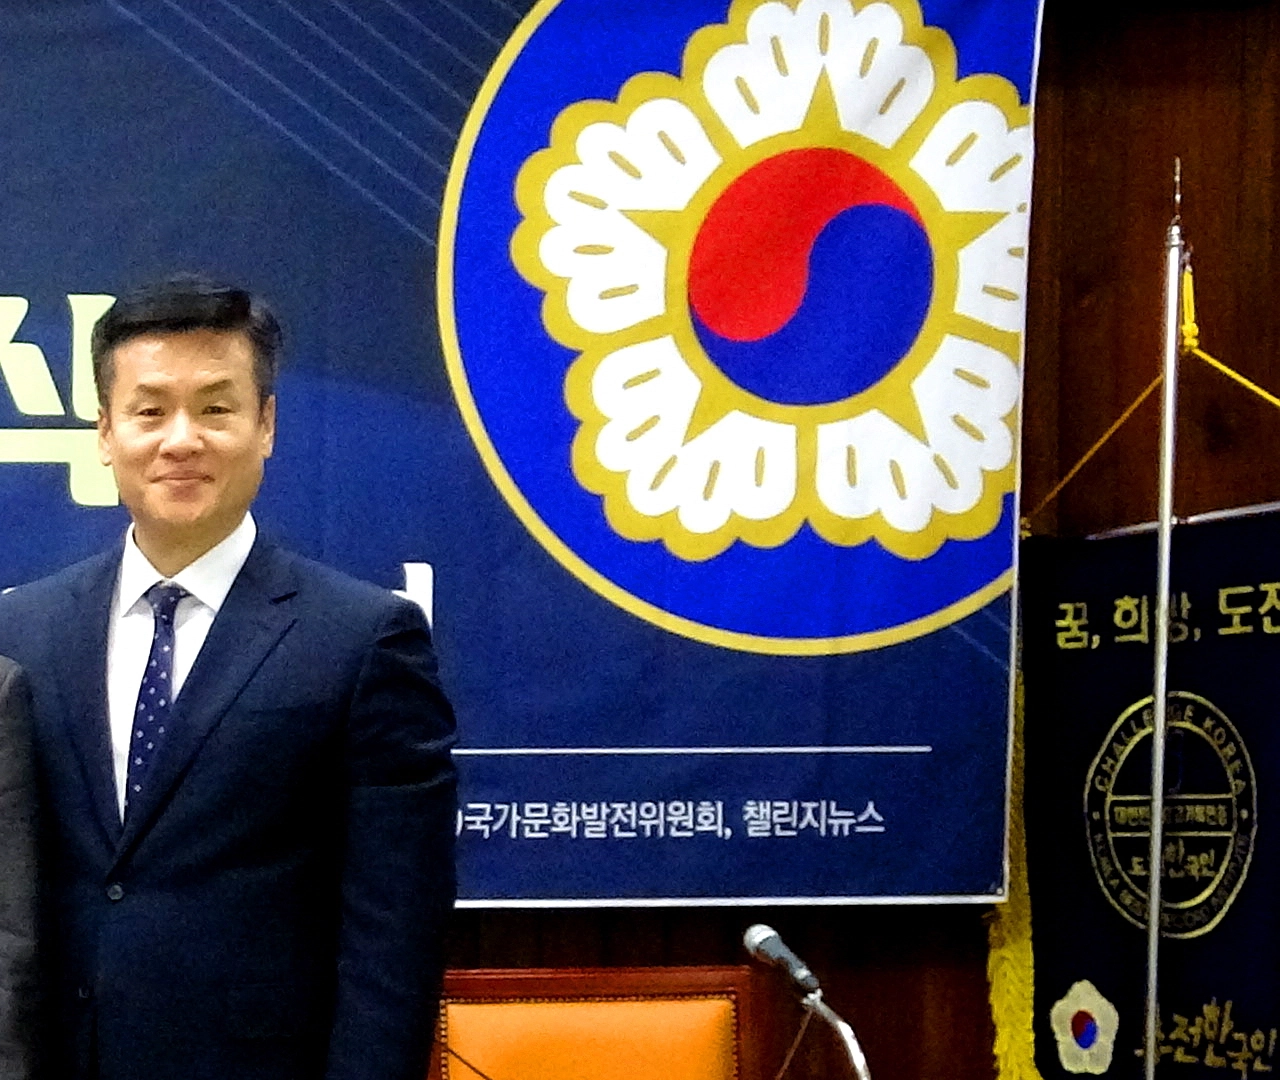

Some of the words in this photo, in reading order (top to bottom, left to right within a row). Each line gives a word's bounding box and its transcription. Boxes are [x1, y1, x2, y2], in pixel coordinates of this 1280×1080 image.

[1054, 601, 1101, 650] 꿈,
[1094, 703, 1196, 793] CHALLEGE
[743, 800, 886, 837] 챌린지뉴스
[1126, 837, 1218, 882] 도한국인
